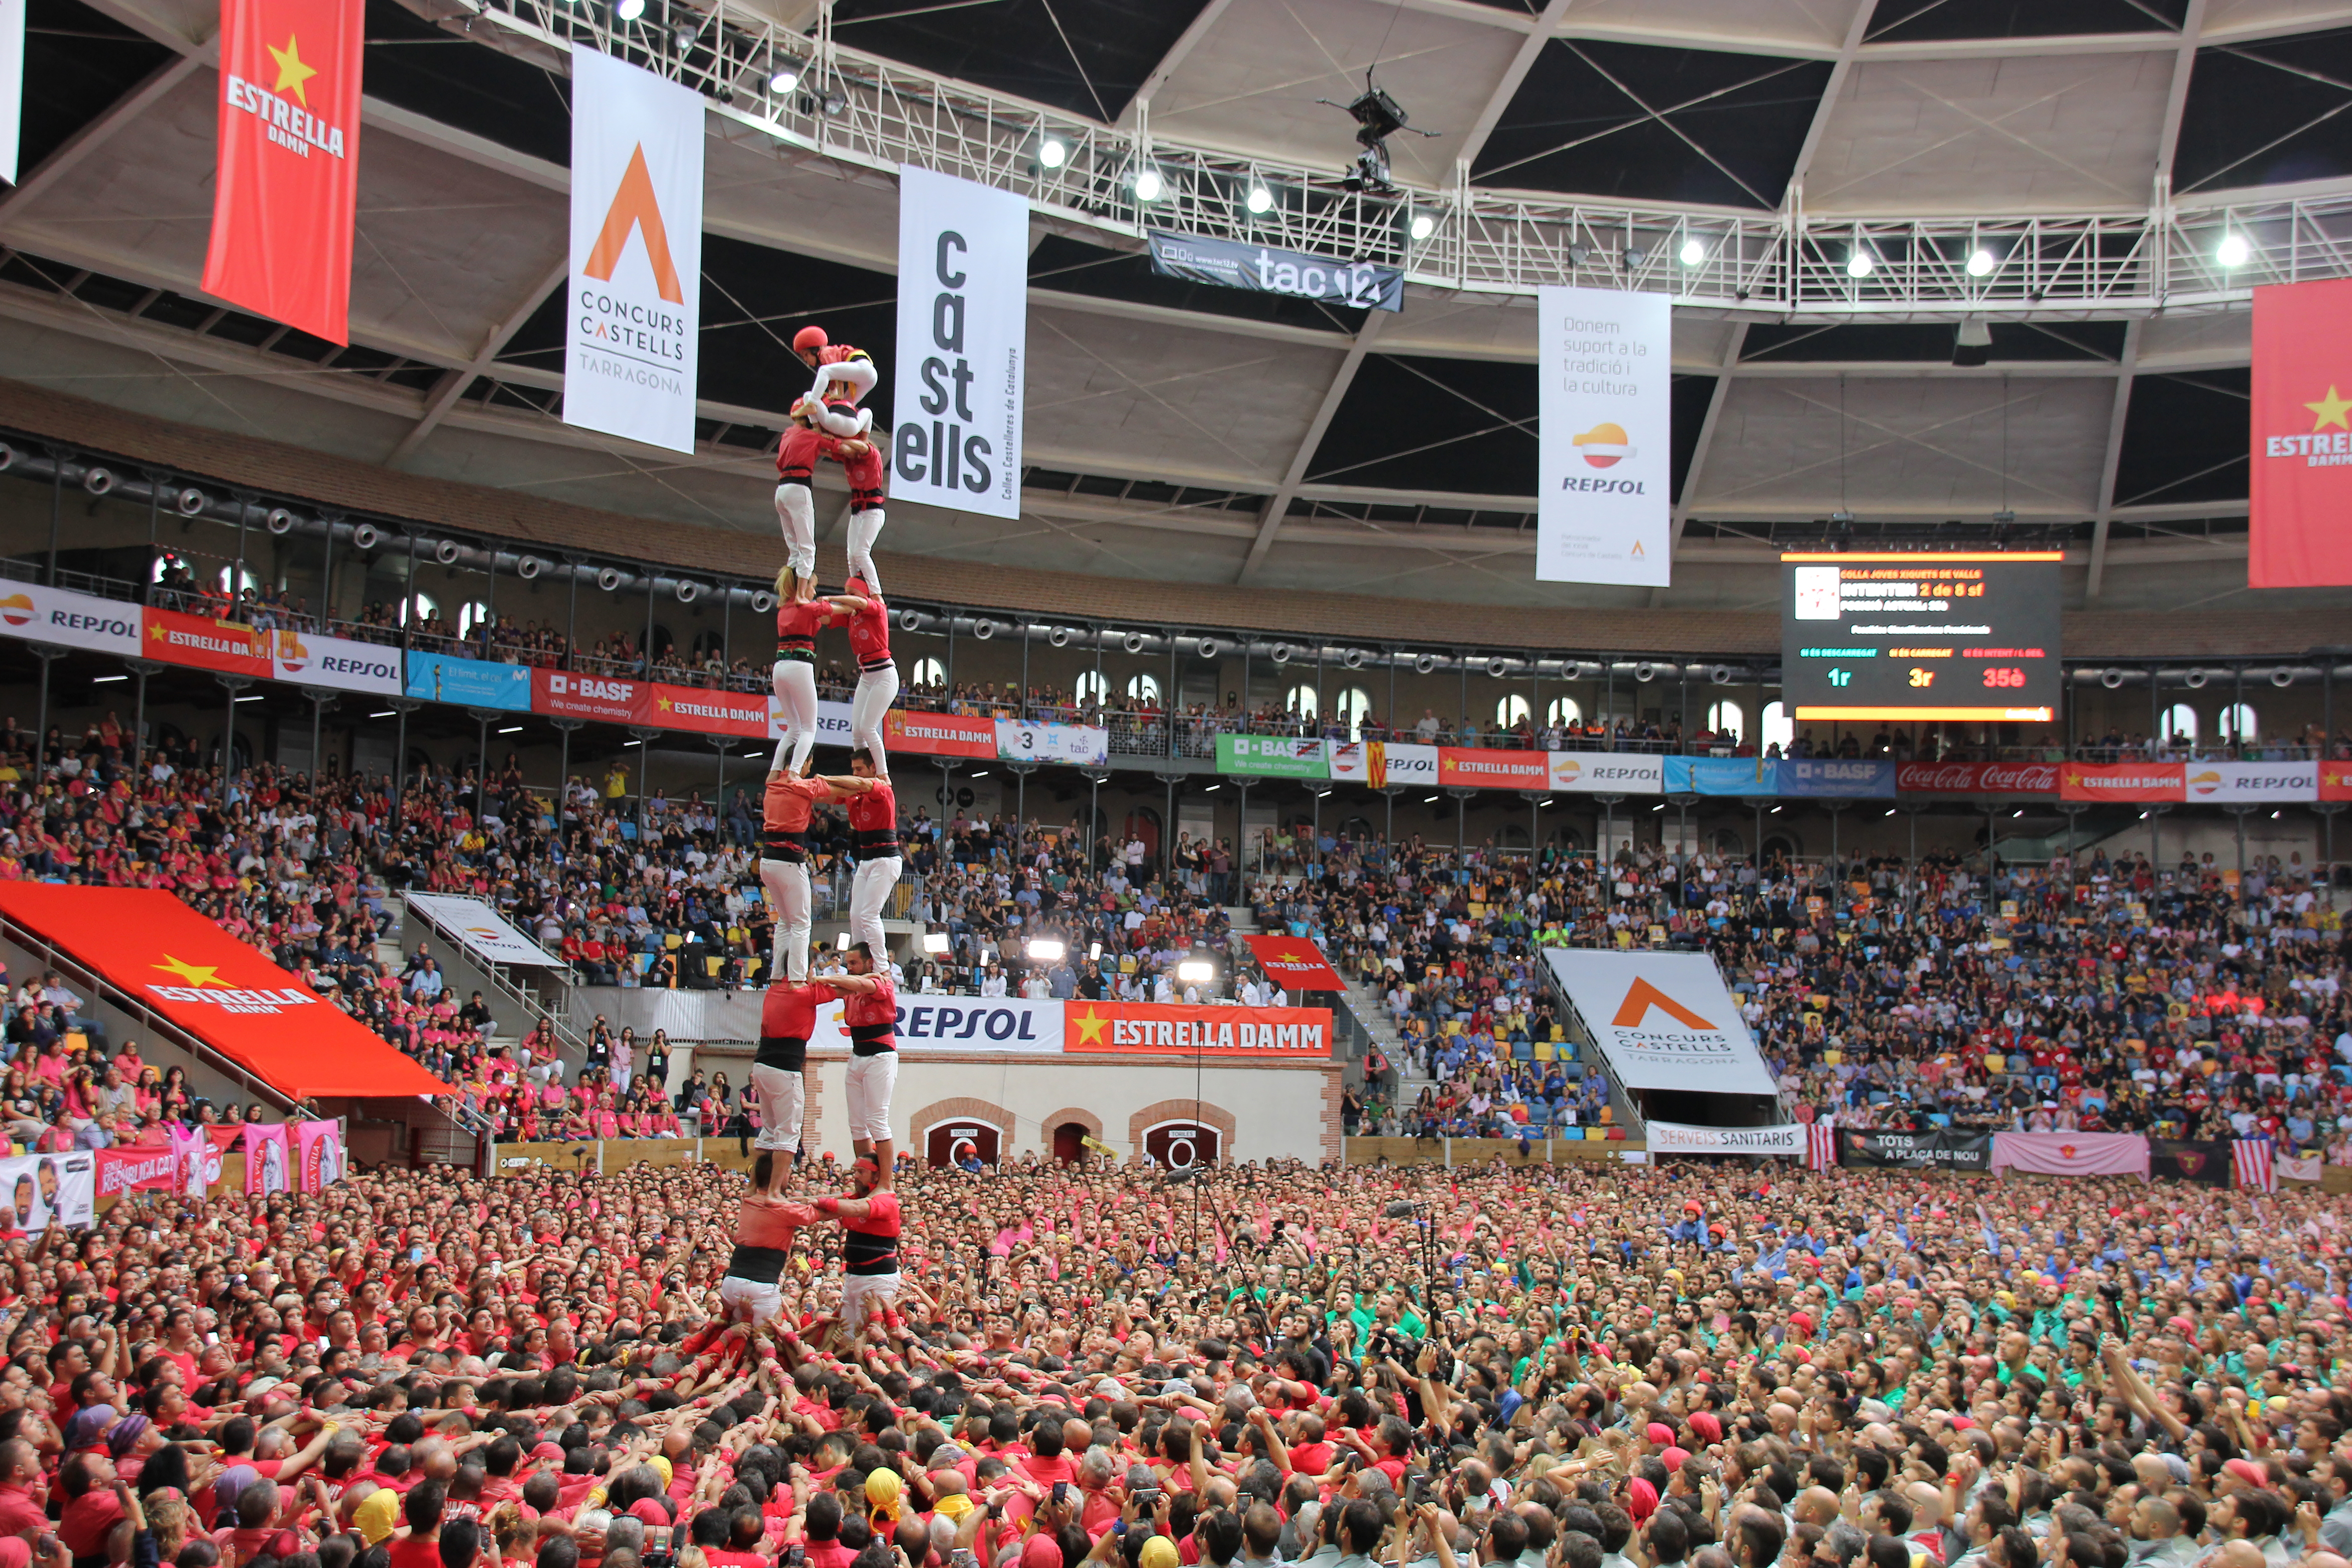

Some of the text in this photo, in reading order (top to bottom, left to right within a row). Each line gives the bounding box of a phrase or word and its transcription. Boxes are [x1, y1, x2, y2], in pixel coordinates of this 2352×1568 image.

[227, 74, 345, 159] ESTRELLA
[267, 124, 309, 159] DAMM
[1255, 248, 1327, 299] tac
[581, 290, 684, 337] CONCURS
[1563, 317, 1620, 335] Donem
[581, 316, 684, 361] CASTELLS
[1563, 339, 1646, 357] suport a la
[580, 353, 683, 397] TARRAGONA
[1563, 357, 1630, 376] tradició i
[1563, 377, 1638, 397] la cultura
[2266, 432, 2352, 457] ESTRE
[1561, 477, 1646, 495] REPSOL
[1840, 569, 1870, 579] COLLA
[1870, 569, 1899, 579] JOVES
[1939, 569, 1953, 579] DE
[1953, 569, 1983, 579] VALLS
[1919, 582, 1932, 597] 2
[1932, 582, 1954, 597] de
[1954, 582, 1967, 597] 8
[52, 610, 137, 639] REPSOL
[169, 630, 230, 655] ESTRELLA
[322, 656, 398, 679] REPSOL
[1828, 667, 1852, 687] 1r
[1908, 667, 1935, 687] 3r
[580, 679, 633, 702] BASF
[550, 698, 632, 720] We create chemistry
[674, 701, 765, 723] ESTRELLA DAMM
[905, 726, 992, 744] ESTRELLA DAMM
[1234, 760, 1310, 773] We create chemistry
[1386, 758, 1435, 772] EPSOL
[1458, 761, 1543, 776] ESTRELLA DAMM
[1593, 767, 1659, 781] REPSOL
[1824, 763, 1877, 780] BASF
[2083, 777, 2180, 788] ESTRELLA DAMM
[2235, 777, 2314, 789] REPSOL
[145, 984, 317, 1005] ESTRELLA
[221, 1004, 284, 1014] DAMM
[1113, 1019, 1323, 1049] ESTRELLA DAMM
[1614, 1030, 1726, 1043] CONCURS
[1619, 1039, 1731, 1052] CASTELLS
[1628, 1054, 1740, 1065] TARRAGONA
[1660, 1129, 1793, 1146] SERVEIS SANITARIS
[1876, 1134, 1914, 1147] TOTS
[310, 1145, 321, 1171] VELLA
[1885, 1149, 1980, 1162] A PLAÇA DE NOU
